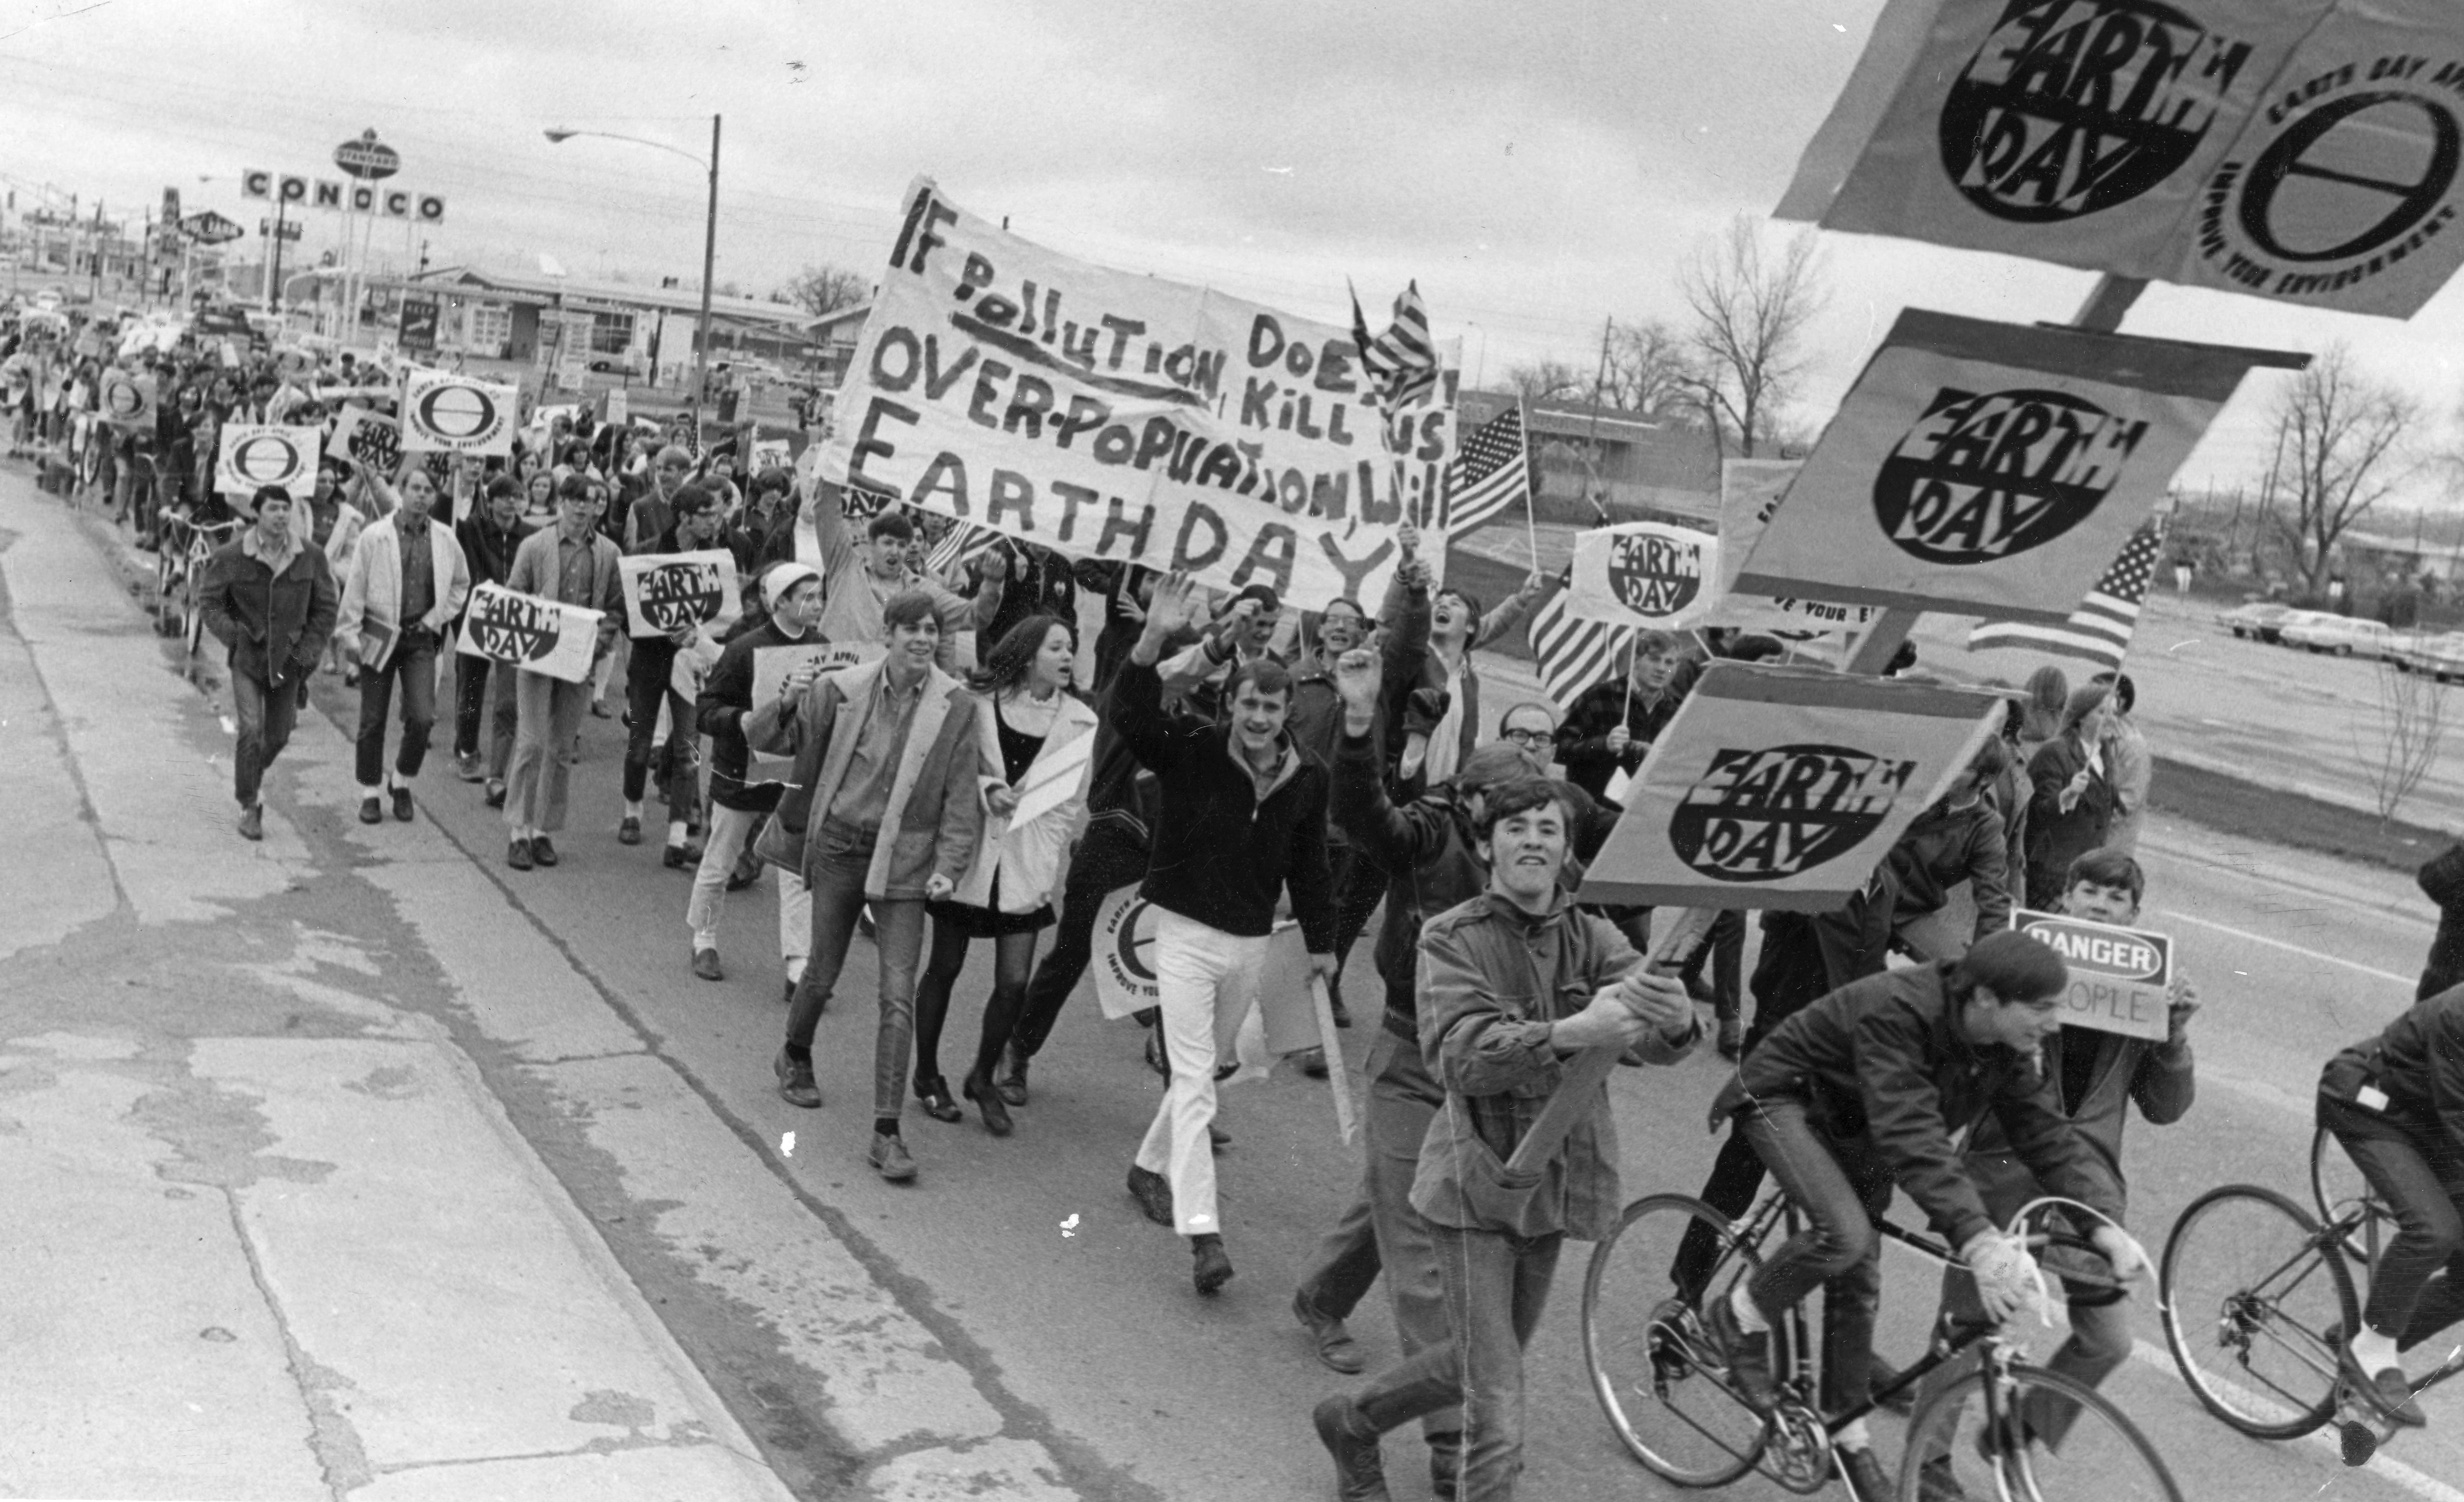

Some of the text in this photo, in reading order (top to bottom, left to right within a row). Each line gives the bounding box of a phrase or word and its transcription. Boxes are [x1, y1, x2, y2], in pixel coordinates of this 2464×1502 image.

[1966, 0, 2254, 133] EARTH
[2266, 62, 2356, 125] EARTH
[2367, 54, 2428, 82] DAY
[337, 148, 398, 167] STANDARD
[1959, 107, 2142, 212] DAY
[248, 172, 442, 219] CONOCO
[889, 187, 958, 276] IF
[2200, 161, 2456, 294] IMPROVE YOUR ENVIRONMENT
[1386, 411, 1445, 461] US
[1895, 387, 2150, 490] EARTH
[847, 396, 1395, 604] EARTH DAY
[1892, 478, 2056, 554] DAY
[1610, 533, 1700, 578] EARTH
[636, 563, 720, 601] EARTH
[1623, 575, 1682, 612] DAY
[471, 589, 561, 633] EARTH
[653, 598, 707, 630] DAY
[1805, 601, 1847, 622] YOUR
[482, 625, 540, 661] DAY
[833, 651, 860, 666] APRIL
[1686, 748, 1918, 814] EARTH
[1693, 817, 1837, 872] DAY
[1107, 899, 1131, 934] EARTH
[1107, 952, 1138, 996] IMPROVE
[2068, 981, 2150, 1023] OPLE
